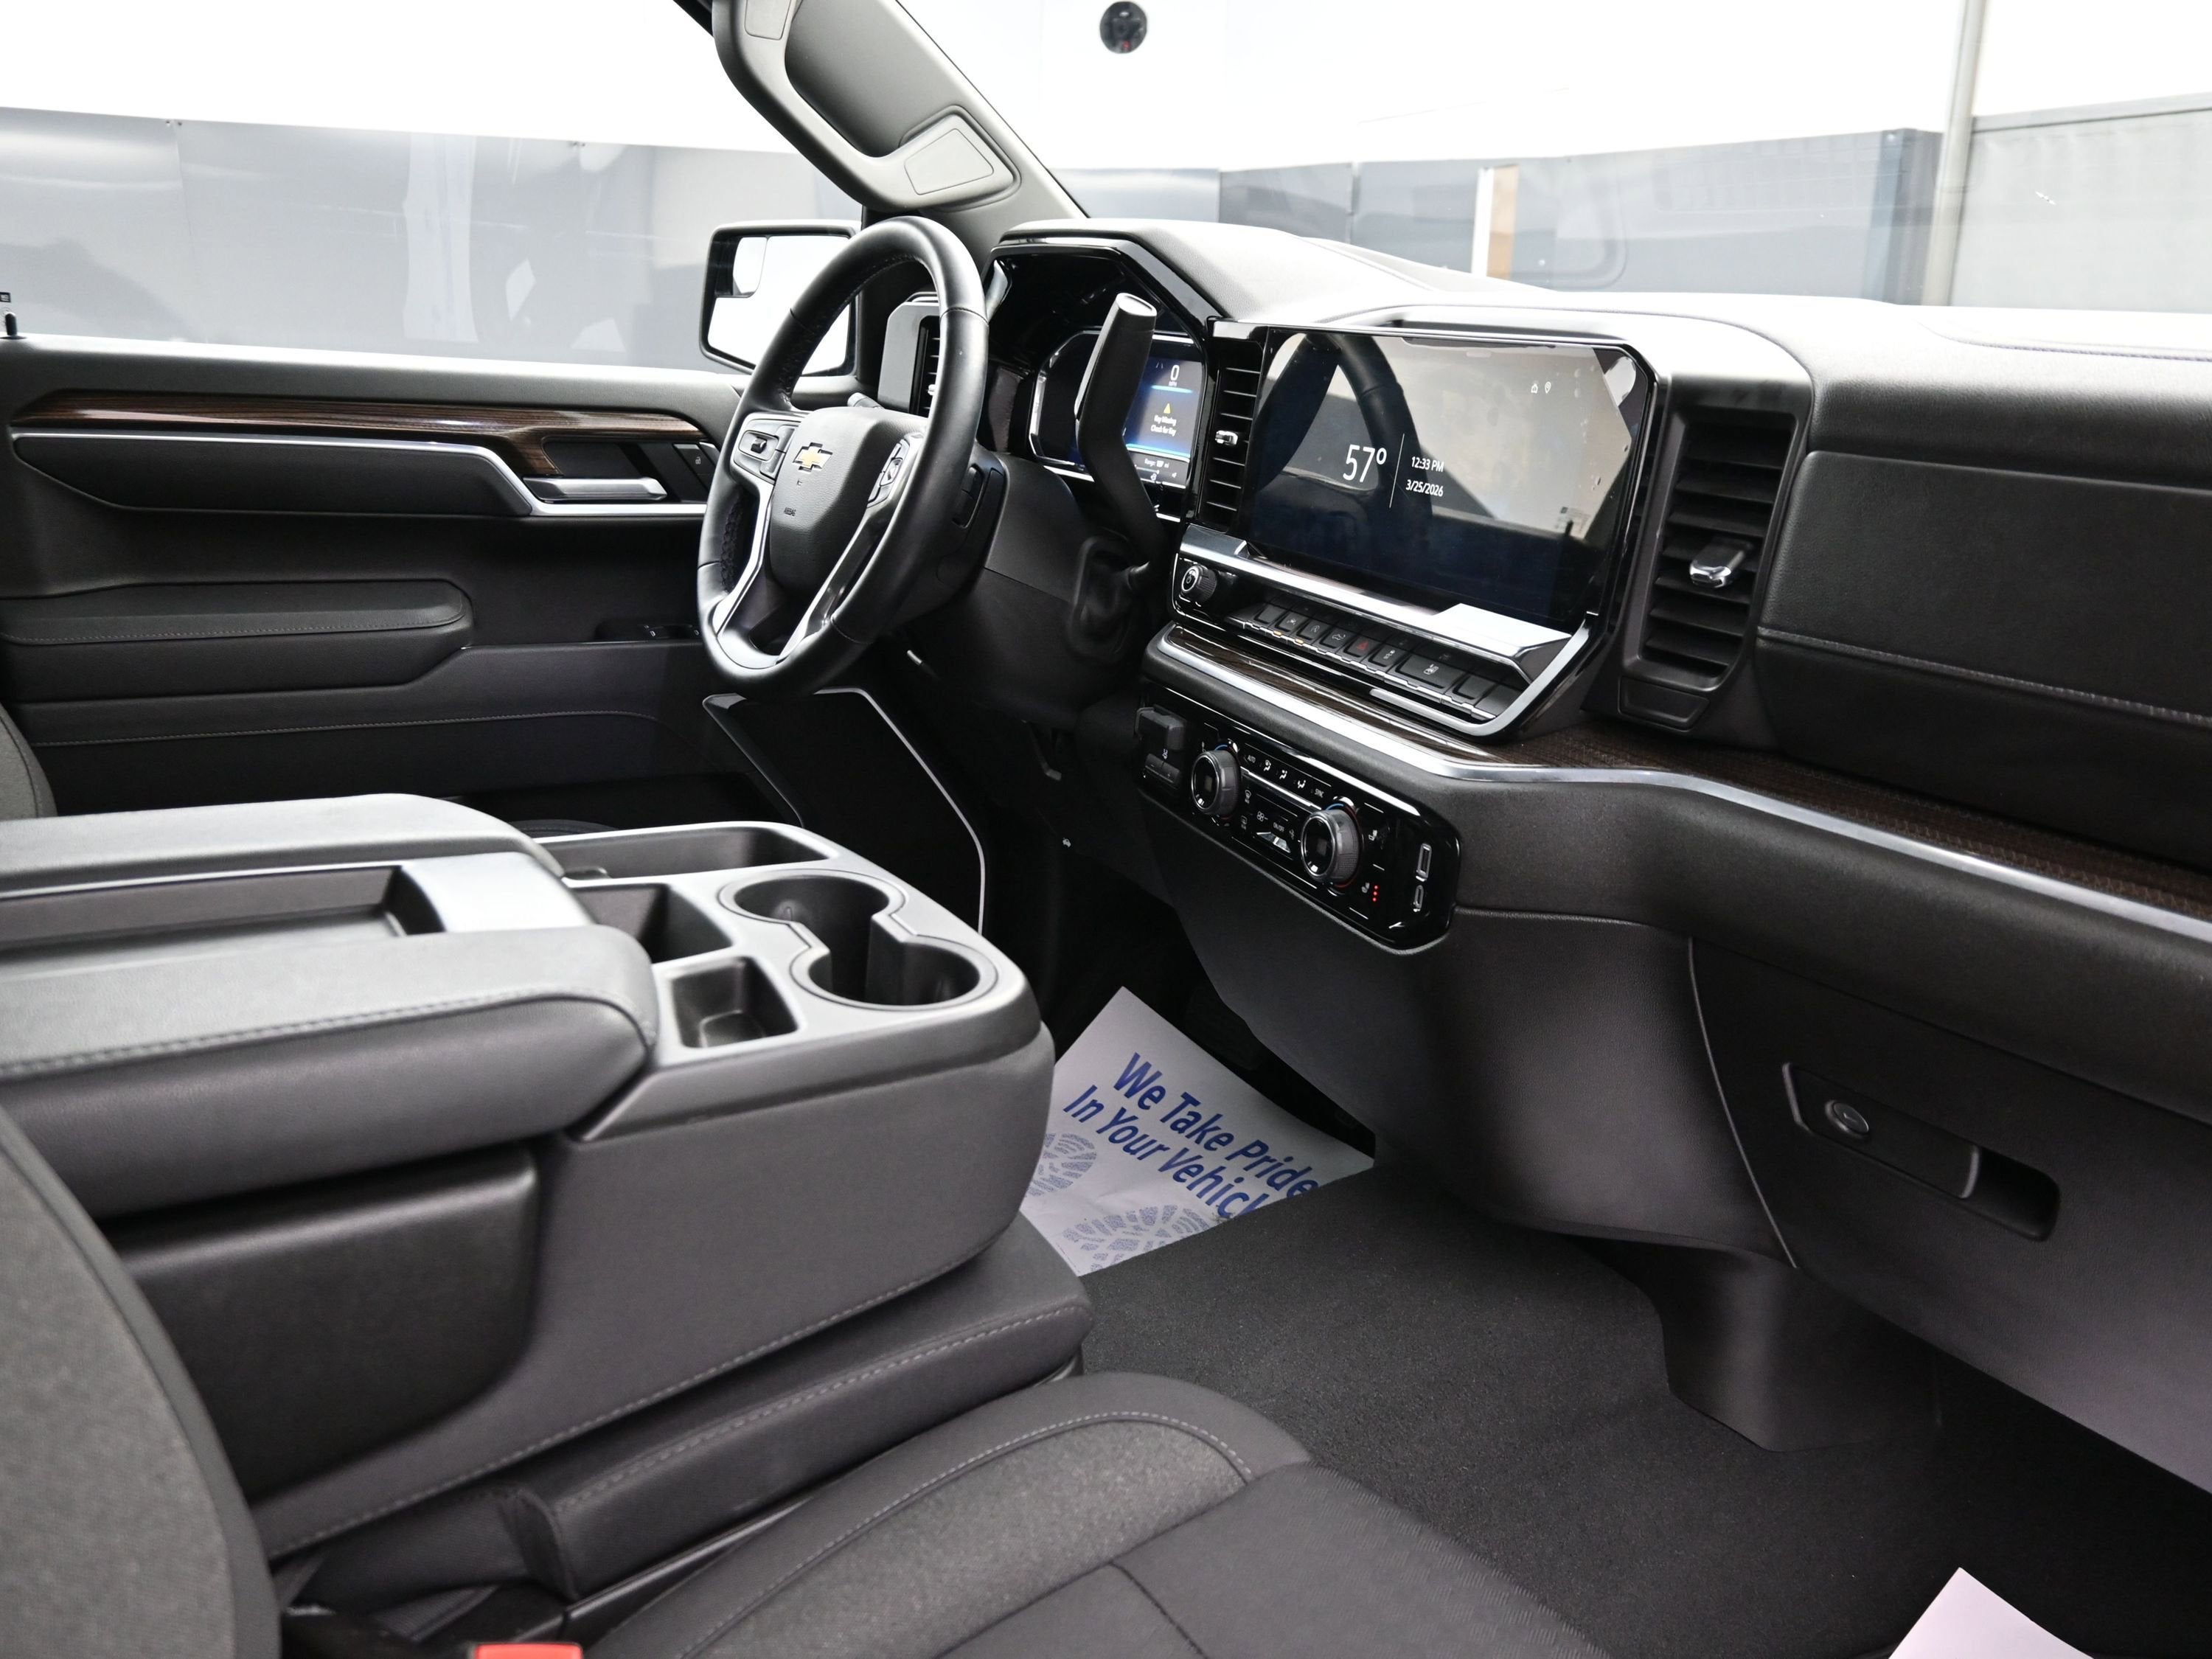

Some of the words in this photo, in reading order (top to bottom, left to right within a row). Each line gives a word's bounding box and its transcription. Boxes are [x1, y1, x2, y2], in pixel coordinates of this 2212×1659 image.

[1170, 364, 1180, 381] 0
[1411, 456, 1431, 470] 12:33
[1431, 460, 1444, 473] PM
[1405, 479, 1444, 497] 3/25/2026
[1247, 755, 1256, 763] AUTO
[1315, 788, 1325, 799] SYNC
[1062, 1085, 1105, 1124] In
[1096, 1107, 1170, 1161] Your
[1113, 1052, 1166, 1110] We
[1160, 1092, 1235, 1152] Take
[1234, 1139, 1319, 1199] Pride
